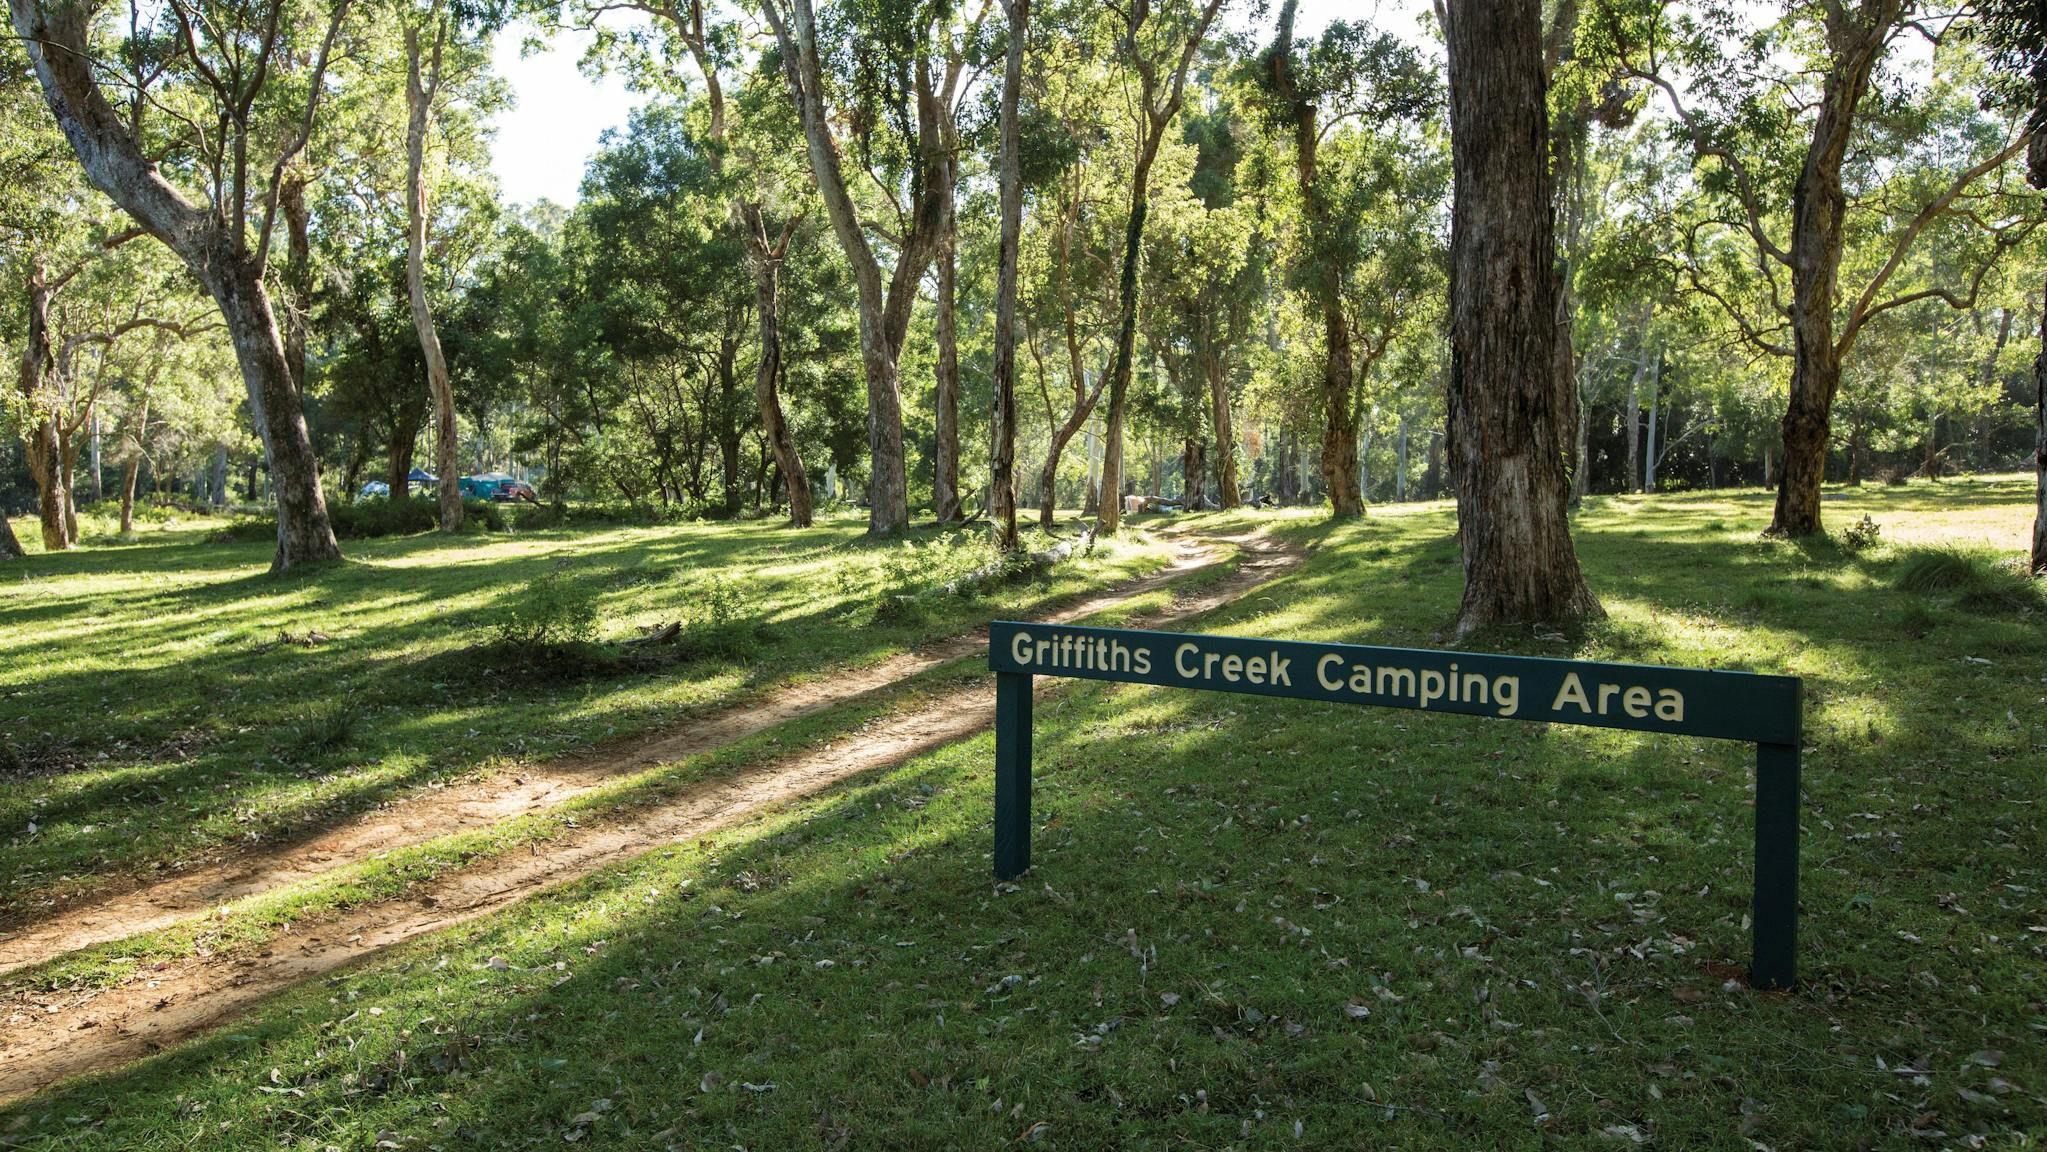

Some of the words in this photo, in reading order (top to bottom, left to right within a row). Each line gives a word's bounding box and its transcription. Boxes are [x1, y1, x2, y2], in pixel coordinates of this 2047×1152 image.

[1012, 631, 1152, 675] Griffiths
[1174, 642, 1292, 687] Creek
[1316, 653, 1520, 717] Camping
[1551, 672, 1685, 722] Area
